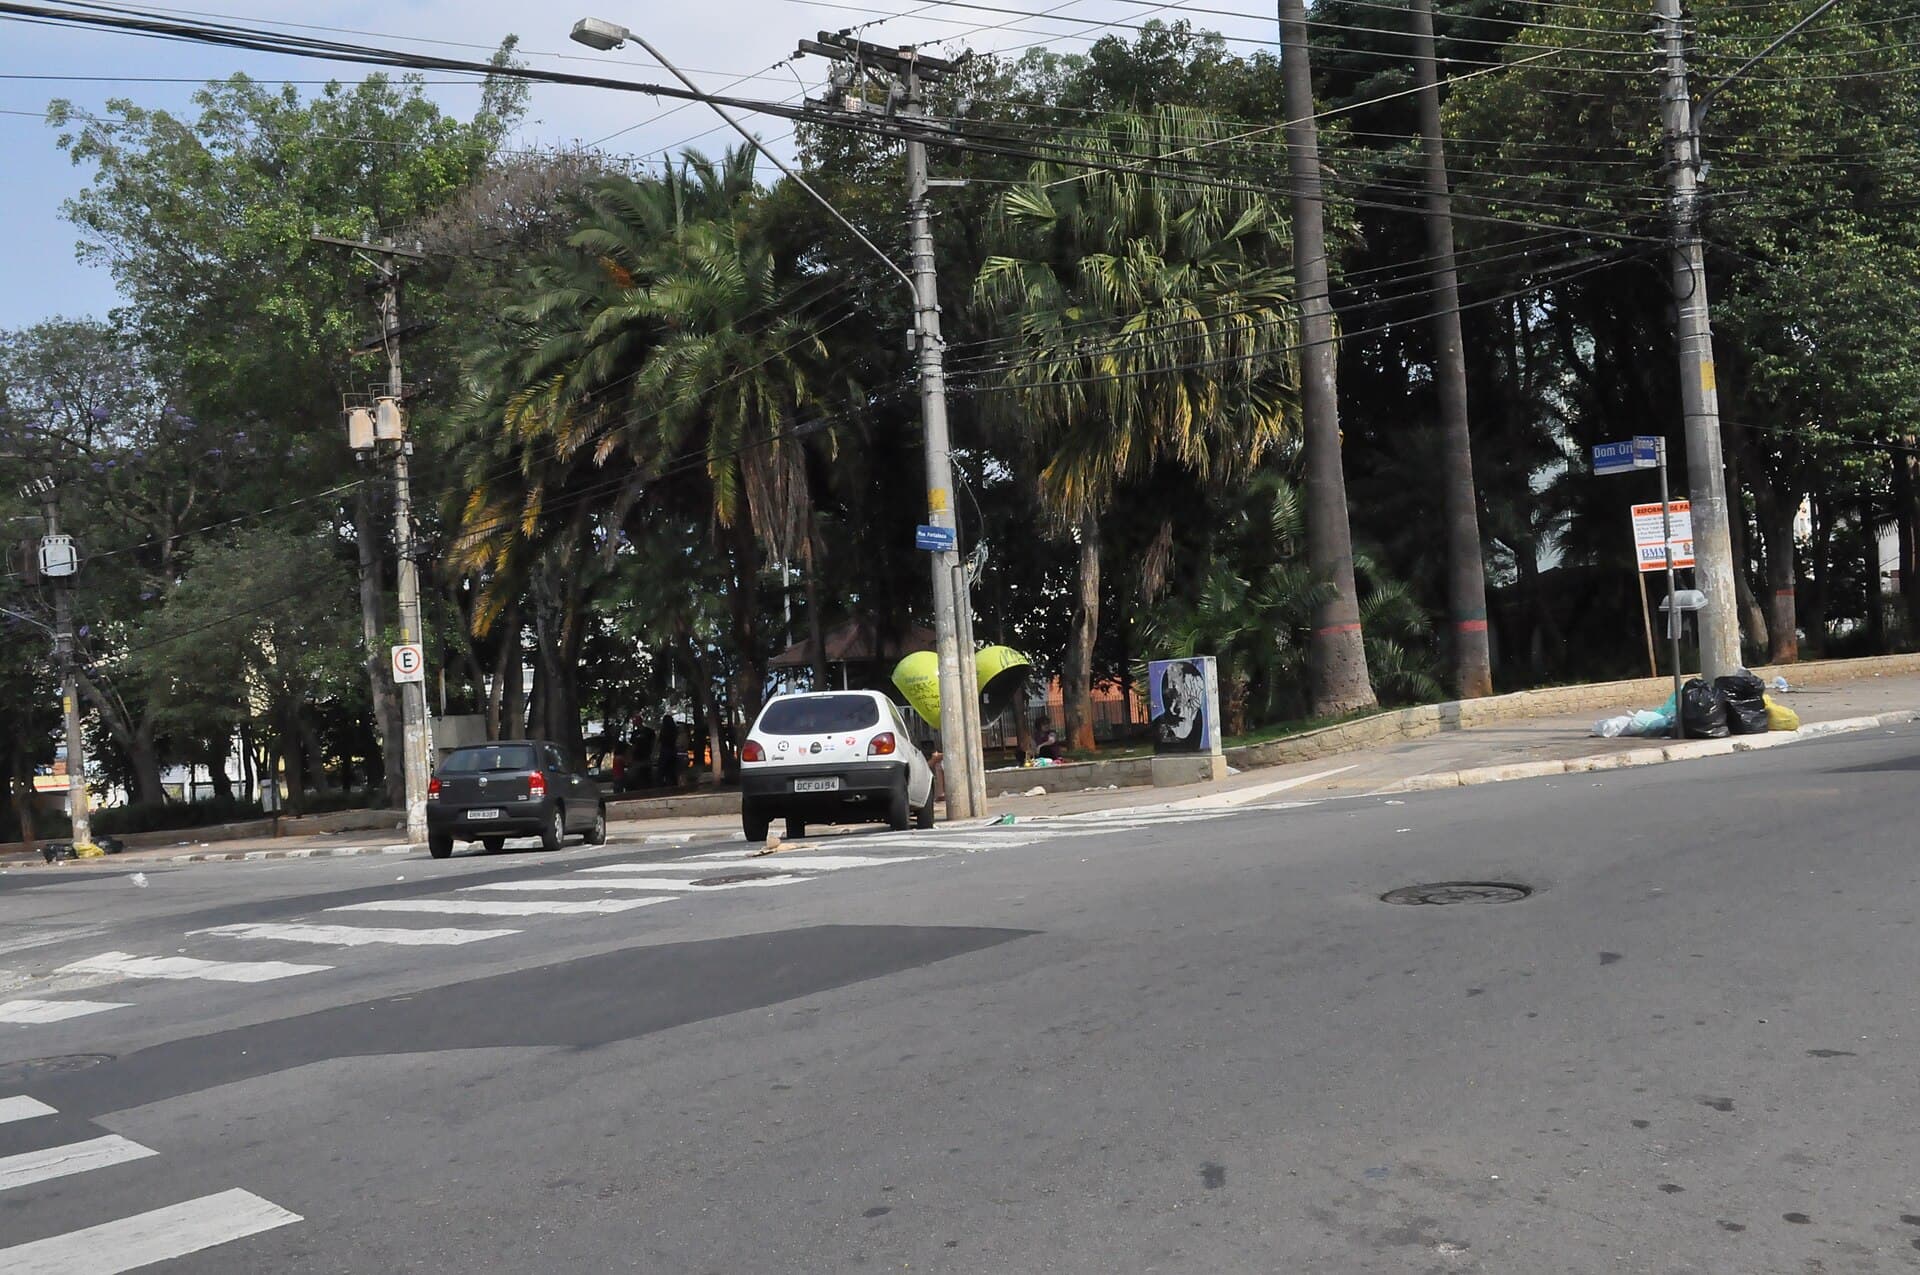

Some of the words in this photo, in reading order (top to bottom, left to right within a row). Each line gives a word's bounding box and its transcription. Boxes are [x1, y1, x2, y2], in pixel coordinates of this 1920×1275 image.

[1594, 447, 1616, 458] Dom
[1619, 444, 1633, 455] Ori
[1637, 505, 1664, 514] REFORM
[402, 652, 412, 668] E
